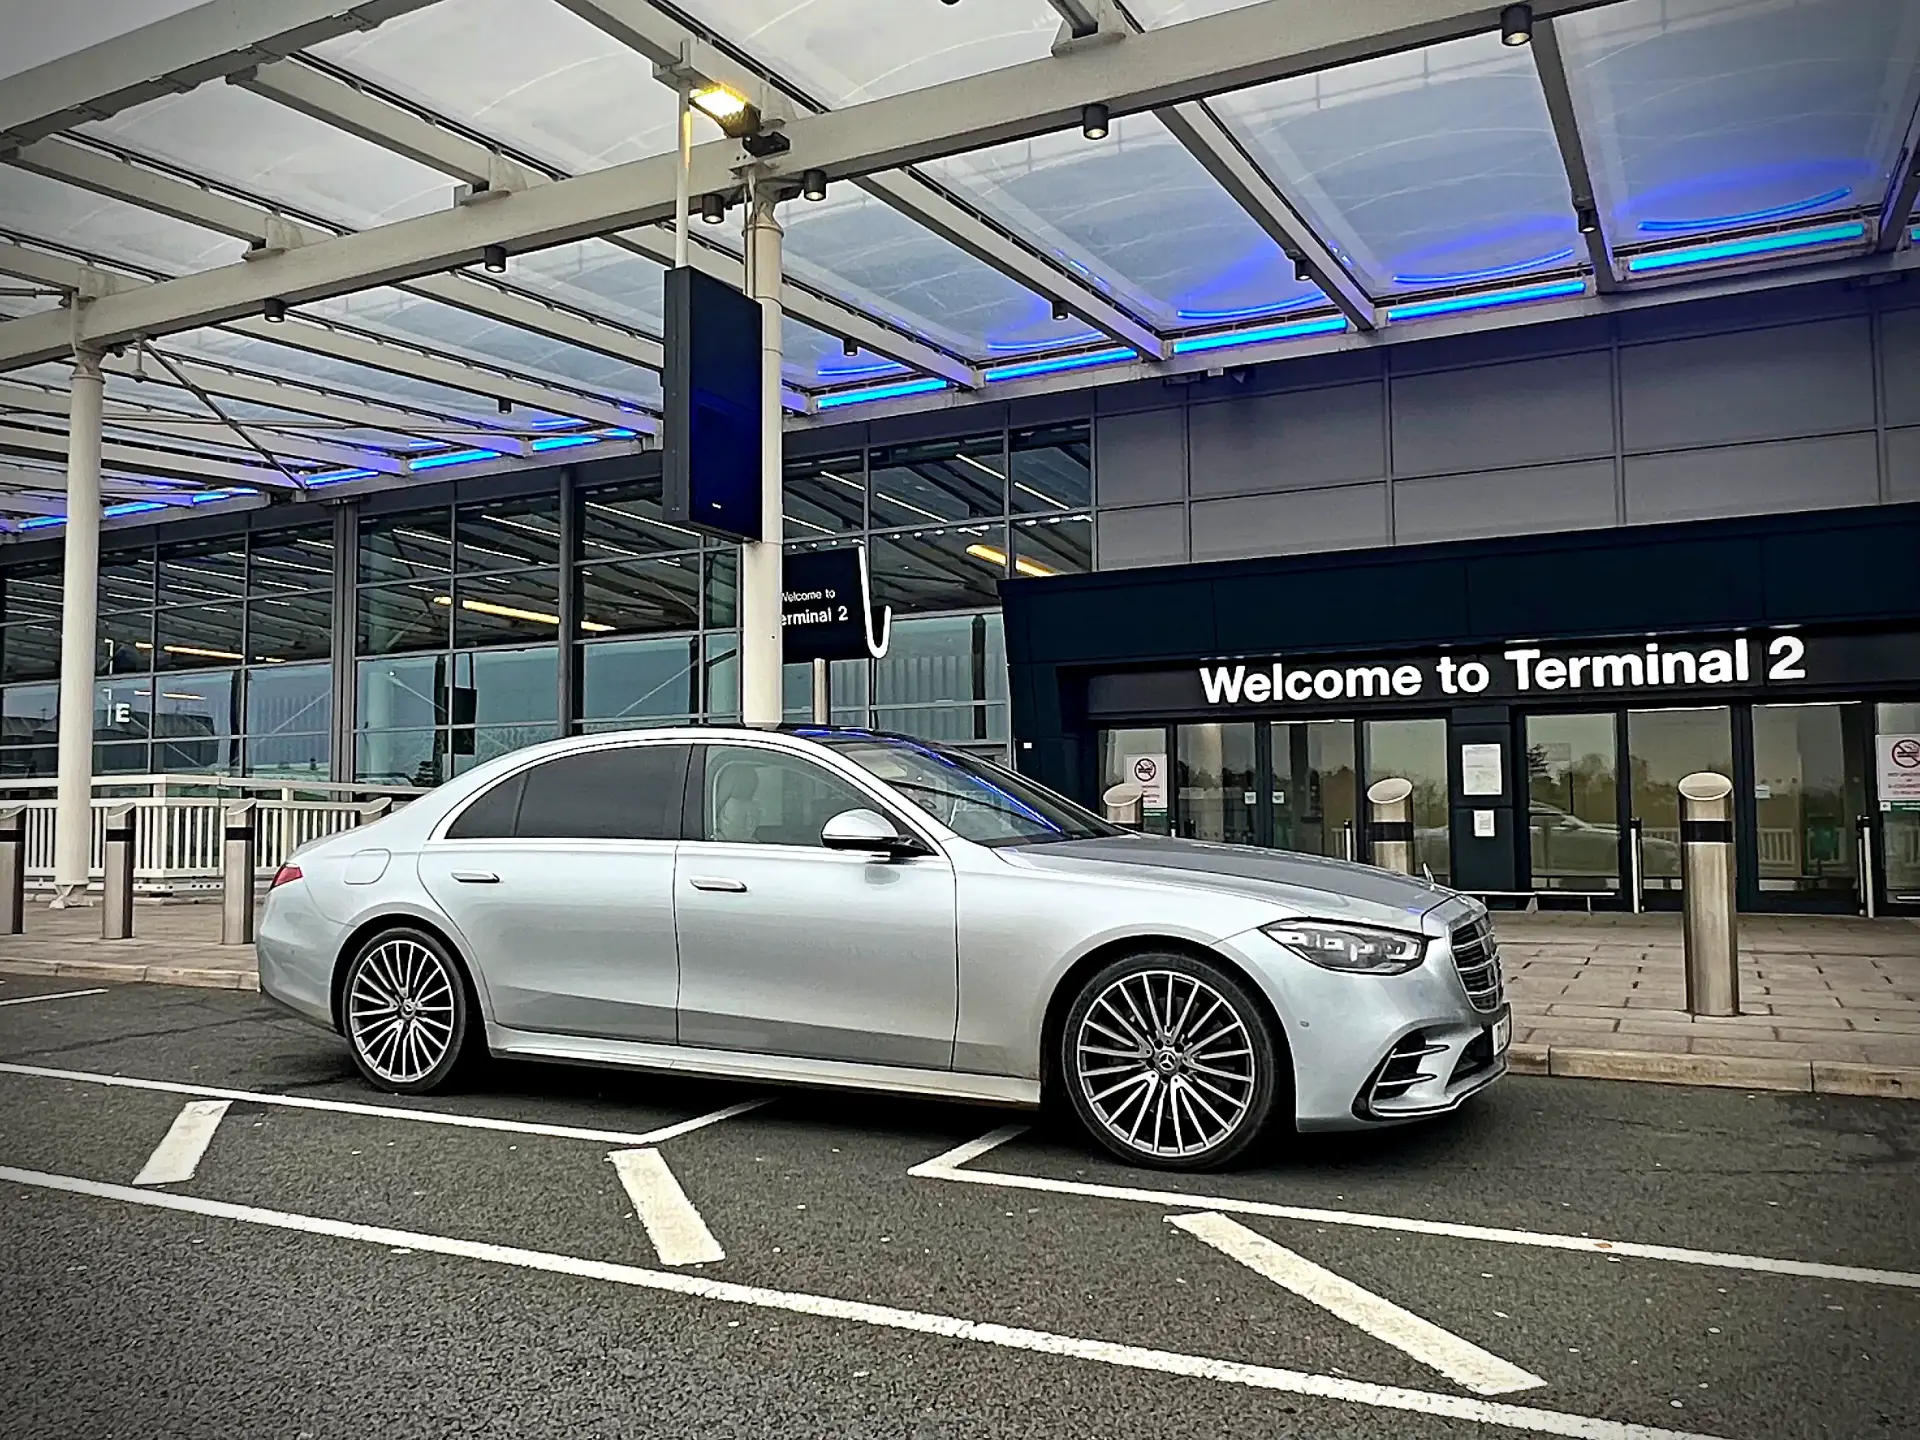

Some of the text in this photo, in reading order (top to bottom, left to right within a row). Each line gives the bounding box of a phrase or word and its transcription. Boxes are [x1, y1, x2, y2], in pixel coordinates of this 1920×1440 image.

[825, 588, 836, 599] to
[781, 605, 849, 626] erminal 2
[1199, 635, 1806, 703] Welcome to Terminal 2
